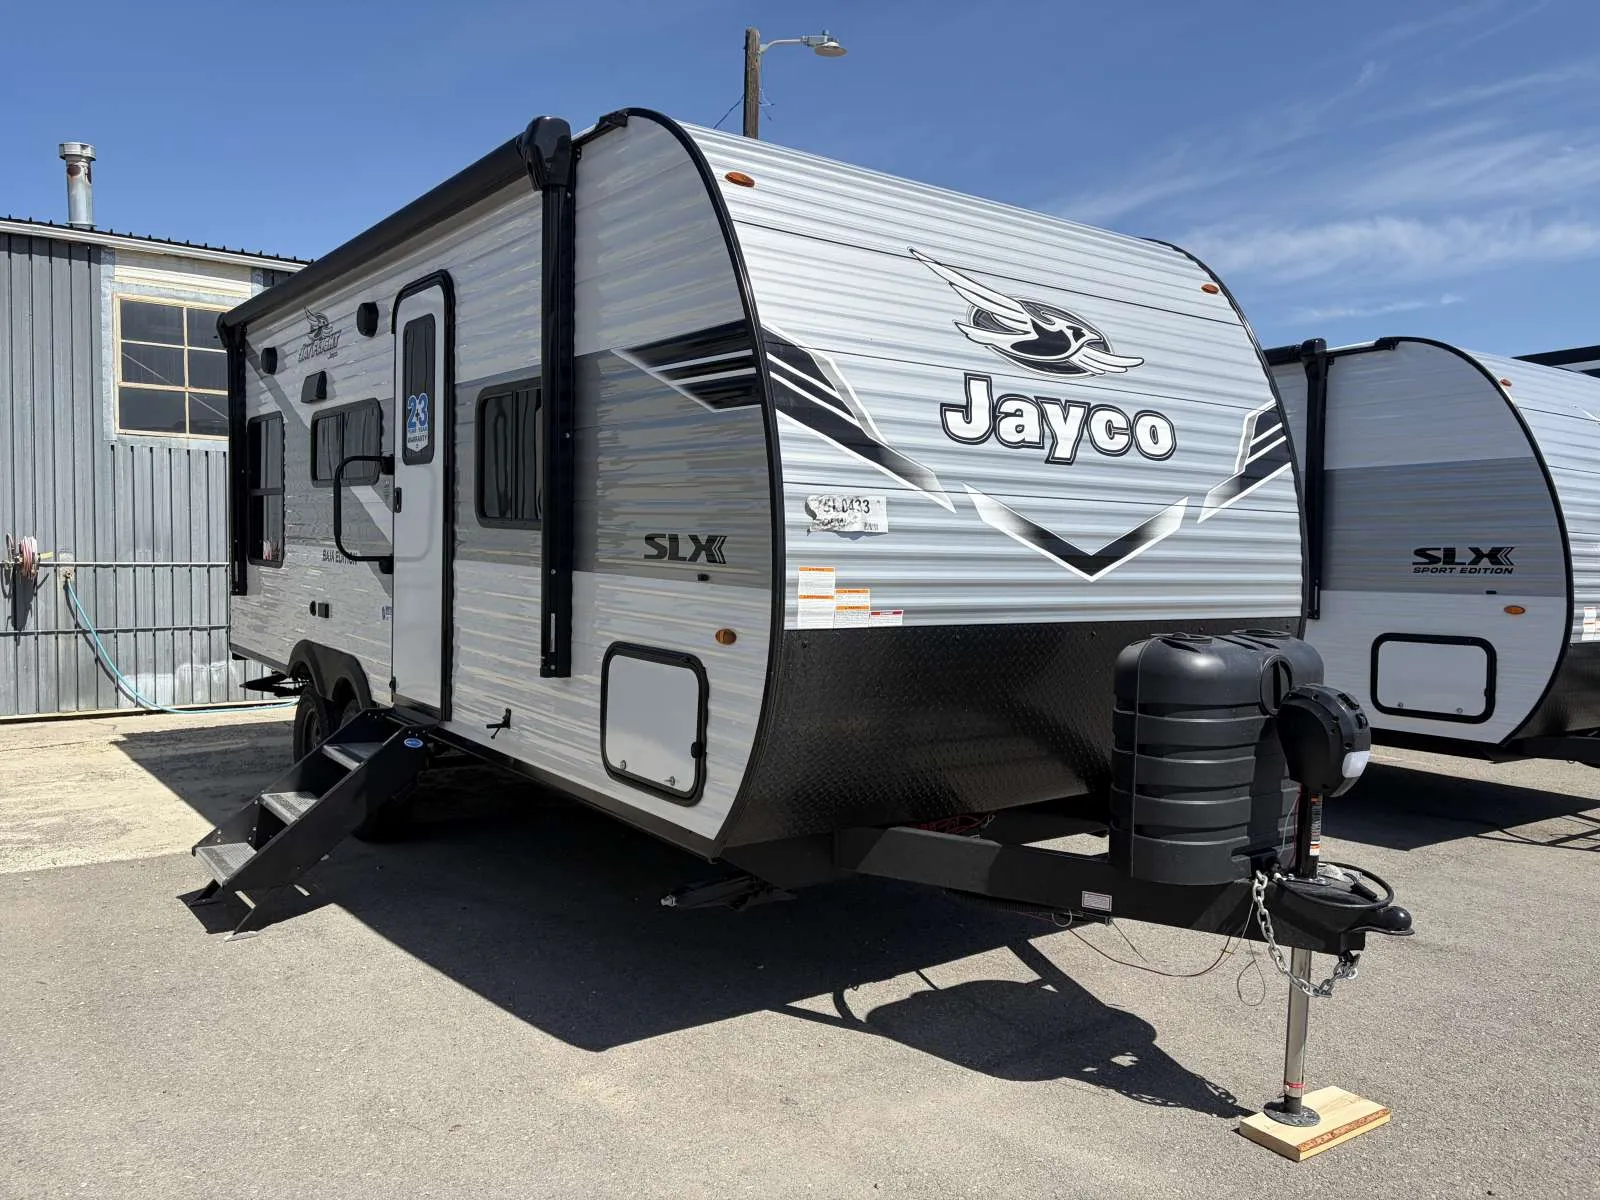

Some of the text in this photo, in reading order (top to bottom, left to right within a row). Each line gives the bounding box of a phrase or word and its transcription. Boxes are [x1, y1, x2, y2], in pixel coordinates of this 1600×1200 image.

[940, 372, 1177, 466] Jayco
[644, 533, 728, 565] SLX
[1412, 546, 1515, 566] SLX
[1412, 567, 1515, 575] SPORT EDITION
